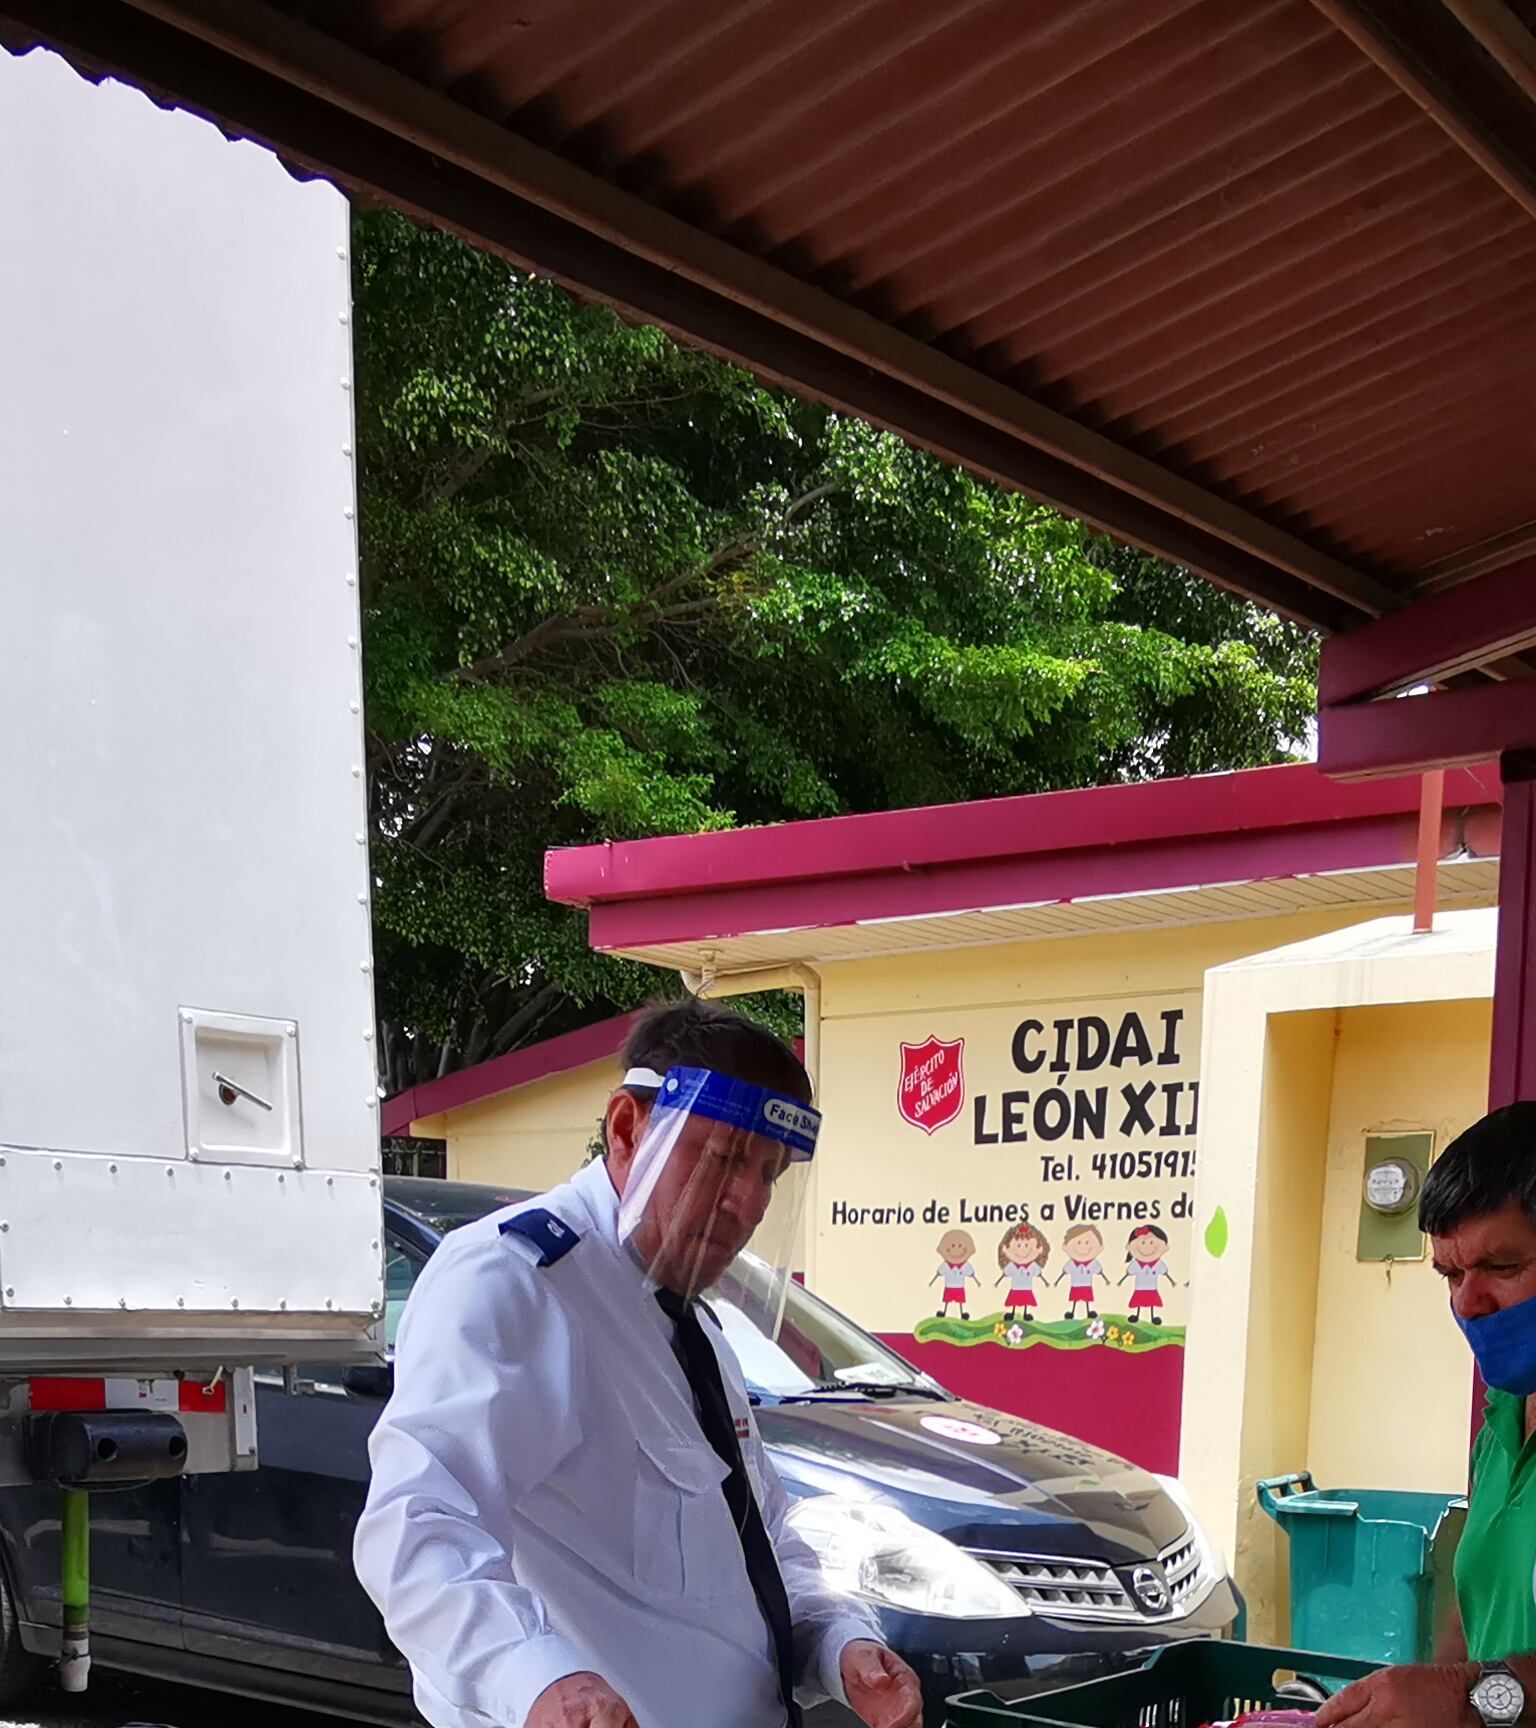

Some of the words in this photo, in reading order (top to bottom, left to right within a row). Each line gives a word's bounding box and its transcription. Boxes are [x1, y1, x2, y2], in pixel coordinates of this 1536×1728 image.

[1011, 1009, 1184, 1074] CIDAI
[921, 1077, 934, 1096] DE
[974, 1073, 1109, 1146] LEÓN
[1040, 1154, 1080, 1183] Tel.
[831, 1200, 915, 1225] Horario
[923, 1198, 950, 1224] de
[959, 1198, 1029, 1223] Lunes
[1040, 1203, 1055, 1221] a
[1064, 1193, 1161, 1221] Viernes
